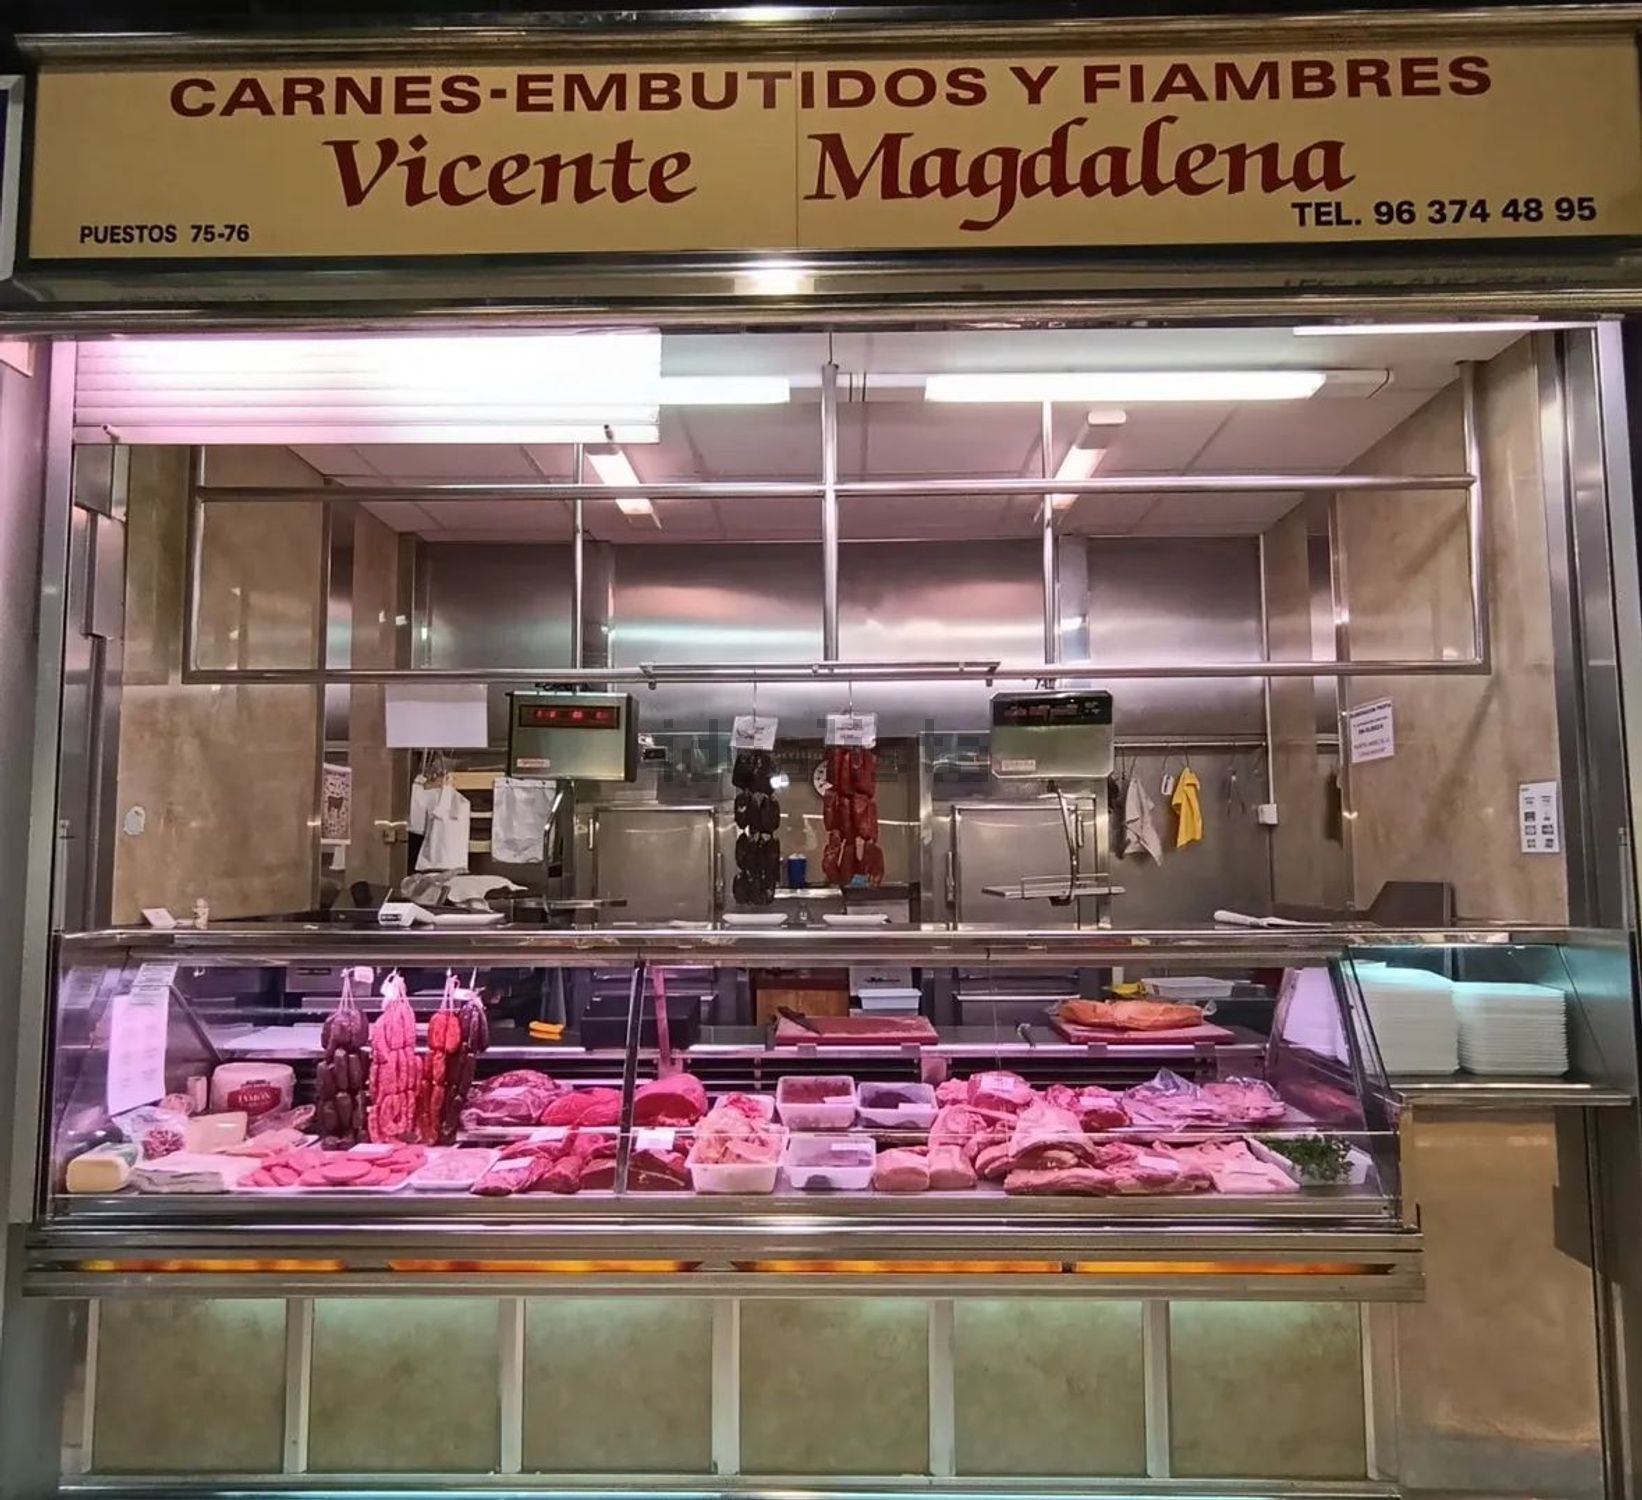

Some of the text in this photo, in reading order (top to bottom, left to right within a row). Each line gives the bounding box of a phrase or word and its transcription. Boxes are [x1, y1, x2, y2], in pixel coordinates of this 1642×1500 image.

[170, 55, 1491, 117] CARNES-EMBUTIDOS Y FIAMBRES
[322, 116, 1356, 231] Vicente Magdalena
[79, 224, 250, 245] PUESTOS 75-76
[1291, 197, 1598, 228] TEL. 96 374 48 95
